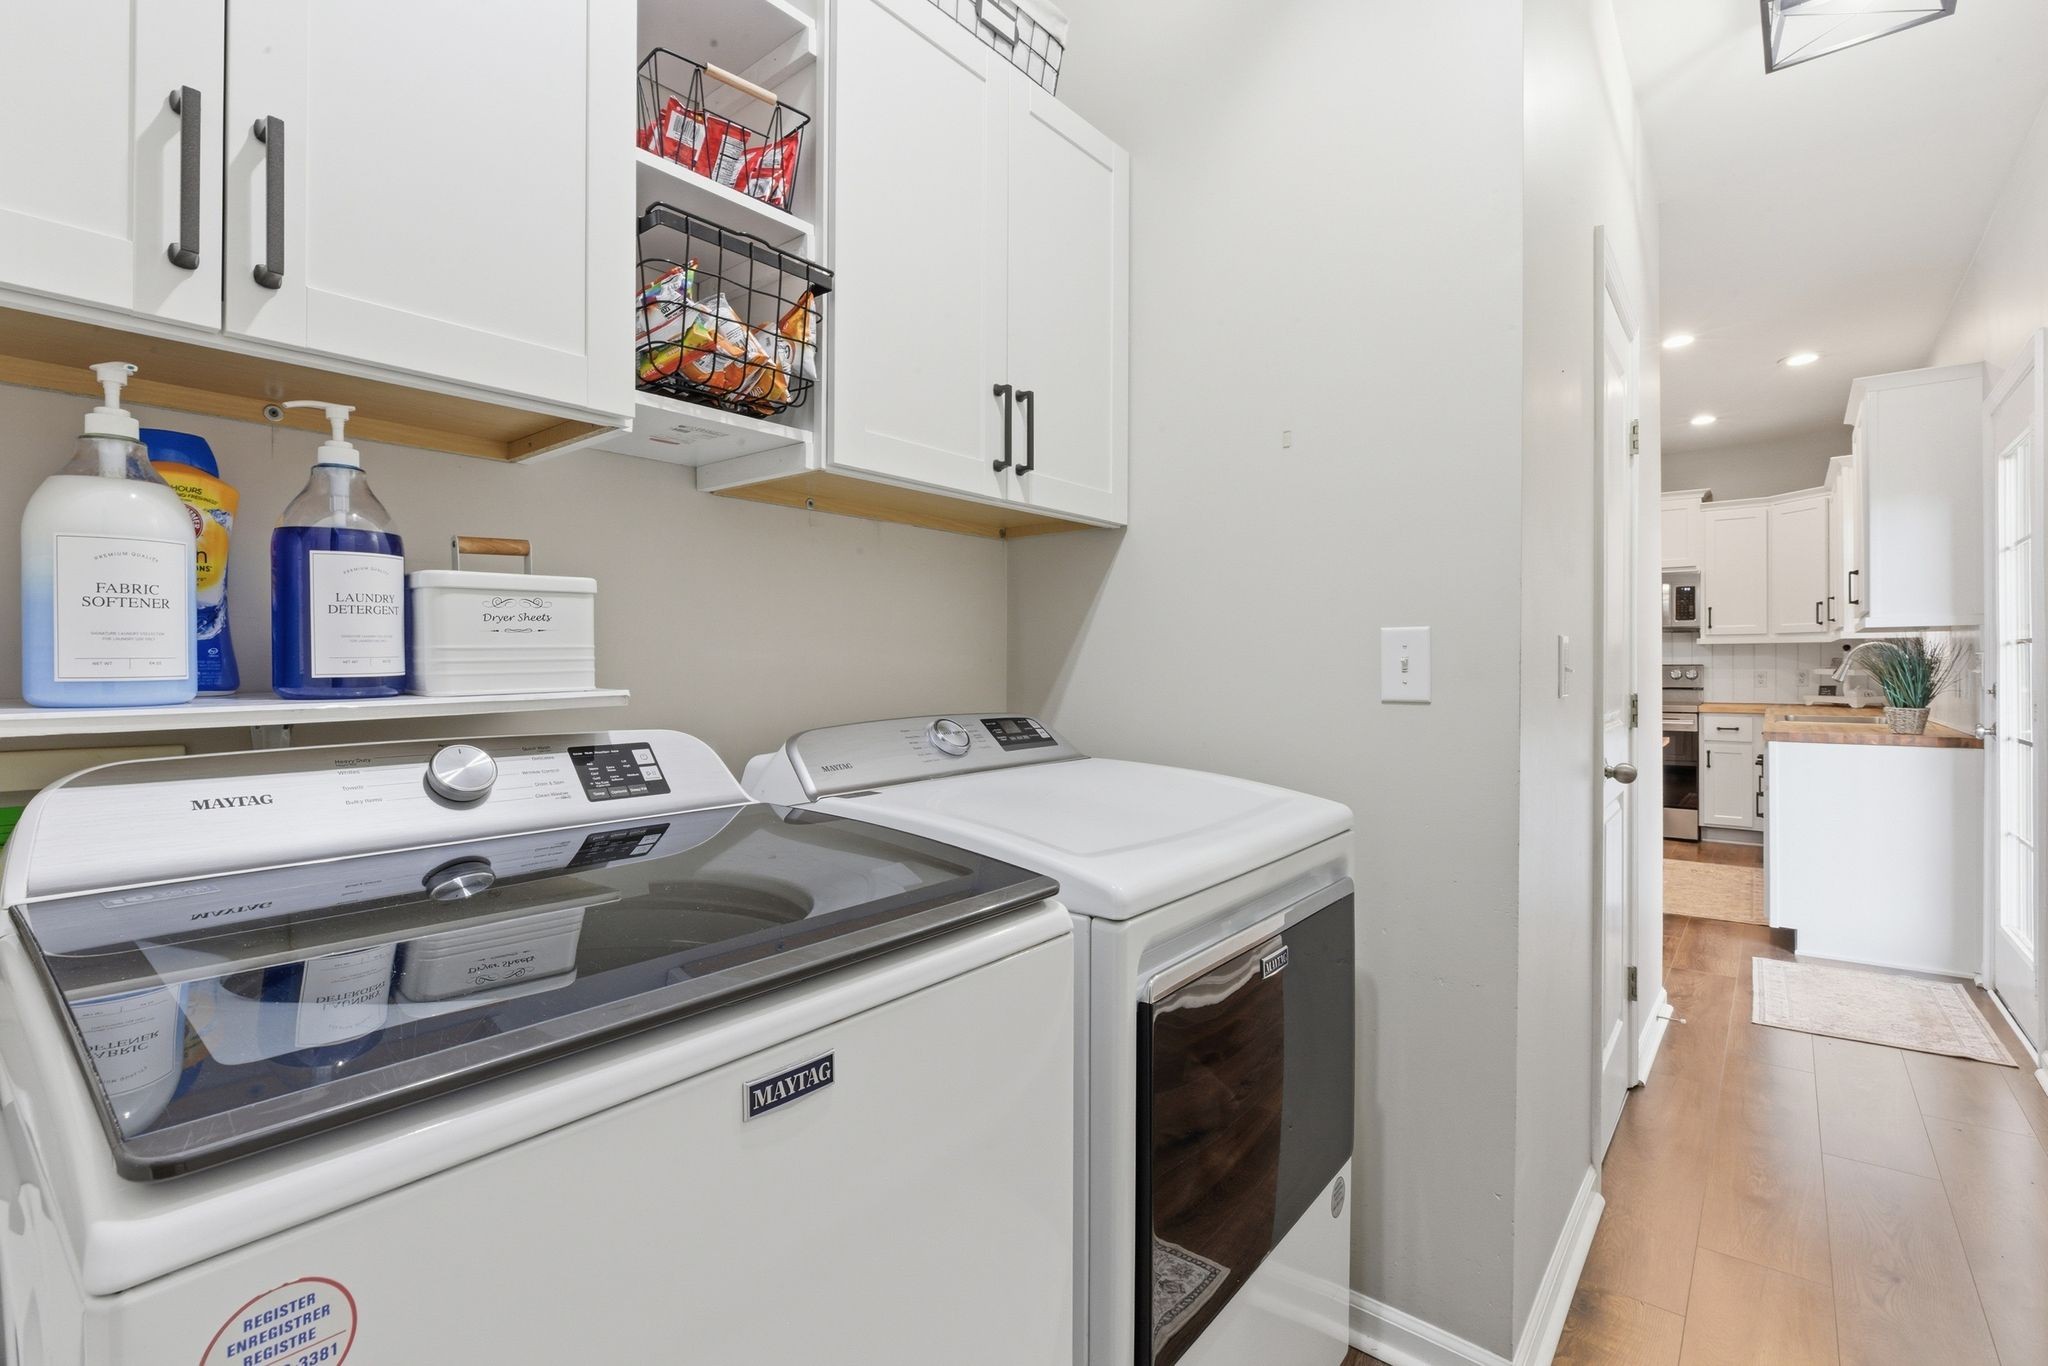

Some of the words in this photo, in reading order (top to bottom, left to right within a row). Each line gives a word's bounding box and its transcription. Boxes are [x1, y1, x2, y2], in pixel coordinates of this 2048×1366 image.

[96, 582, 160, 596] FABRIC
[82, 595, 171, 609] SOFTENER
[335, 592, 396, 604] LAUNDRY
[327, 604, 400, 616] DETERGENT
[482, 612, 516, 625] Dryer
[517, 612, 553, 623] Sheets
[190, 794, 274, 811] MAYTAG
[752, 1061, 832, 1110] MAYTAG
[243, 1292, 316, 1333] REGISTER
[227, 1304, 331, 1358] ENREGISTRER
[243, 1327, 317, 1366] REGISTRE
[284, 1342, 338, 1366] 3381
